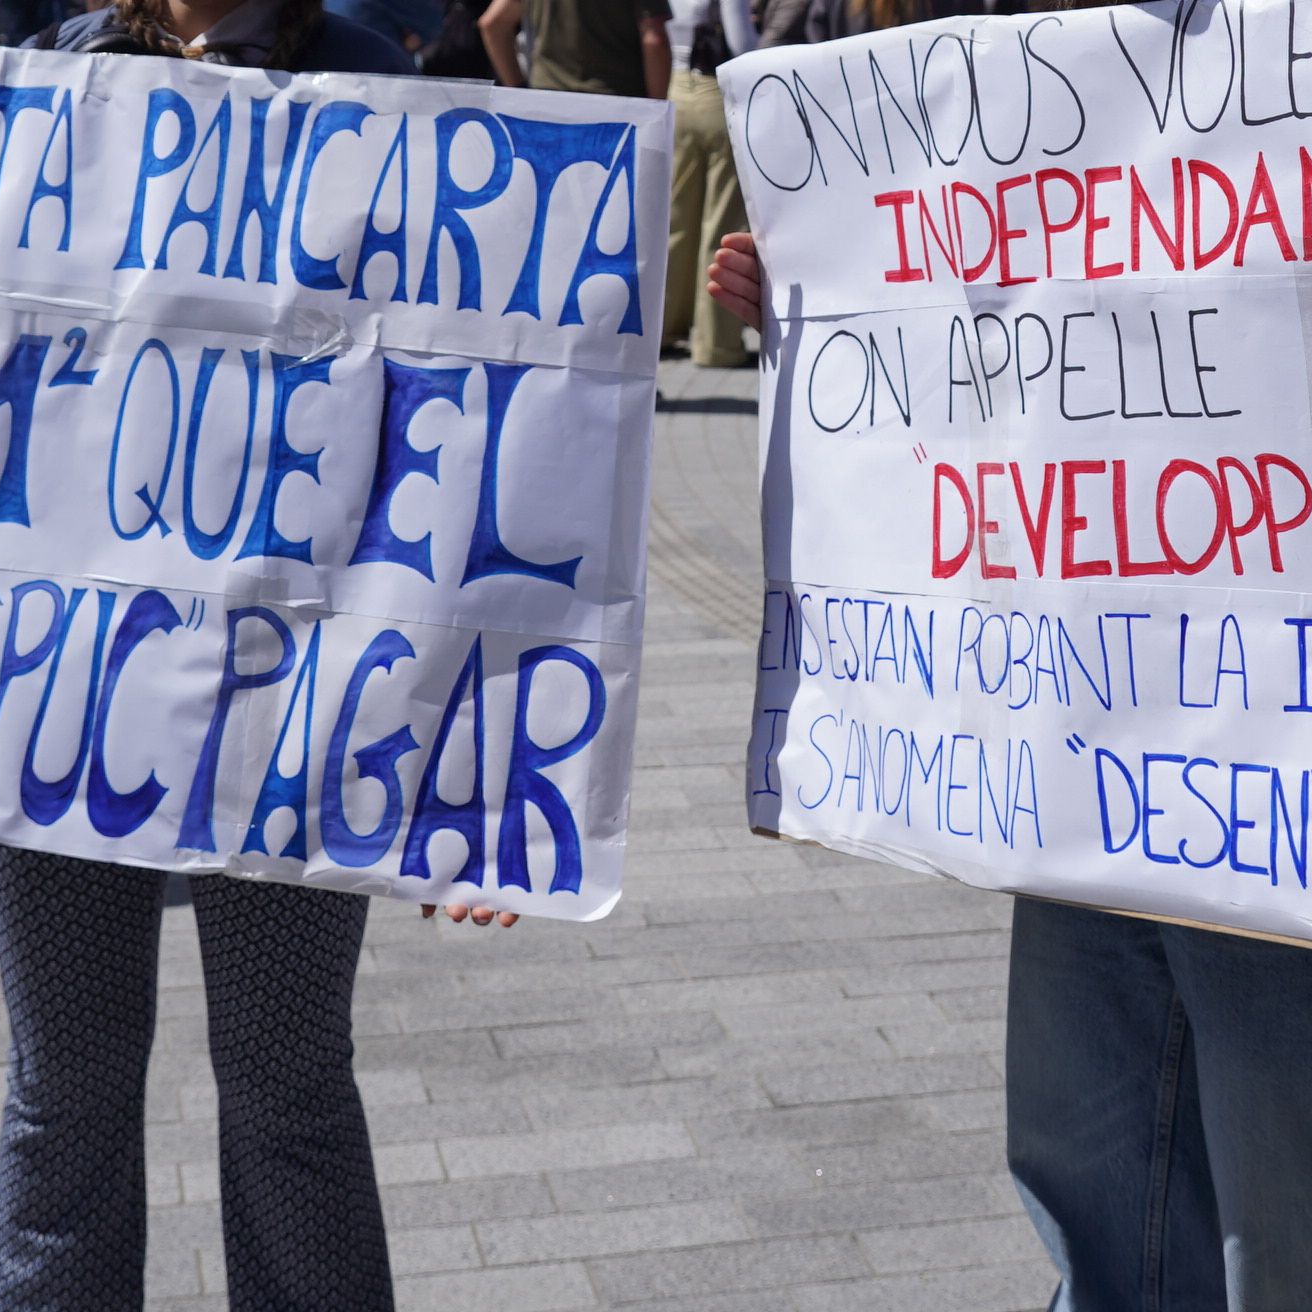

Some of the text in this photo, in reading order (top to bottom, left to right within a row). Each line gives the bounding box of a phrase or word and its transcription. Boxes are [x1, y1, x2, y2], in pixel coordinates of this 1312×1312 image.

[746, 55, 869, 191] ON
[869, 12, 1087, 168] NOUS
[114, 87, 643, 336] PANCARTA
[809, 326, 911, 435] ON
[949, 308, 1243, 423] APPELLE
[954, 605, 1152, 711] ROBANT
[1178, 612, 1250, 710] LA
[175, 605, 607, 896] PAGAR
[753, 708, 789, 797] I
[797, 708, 1043, 849] S'ANOMENA
